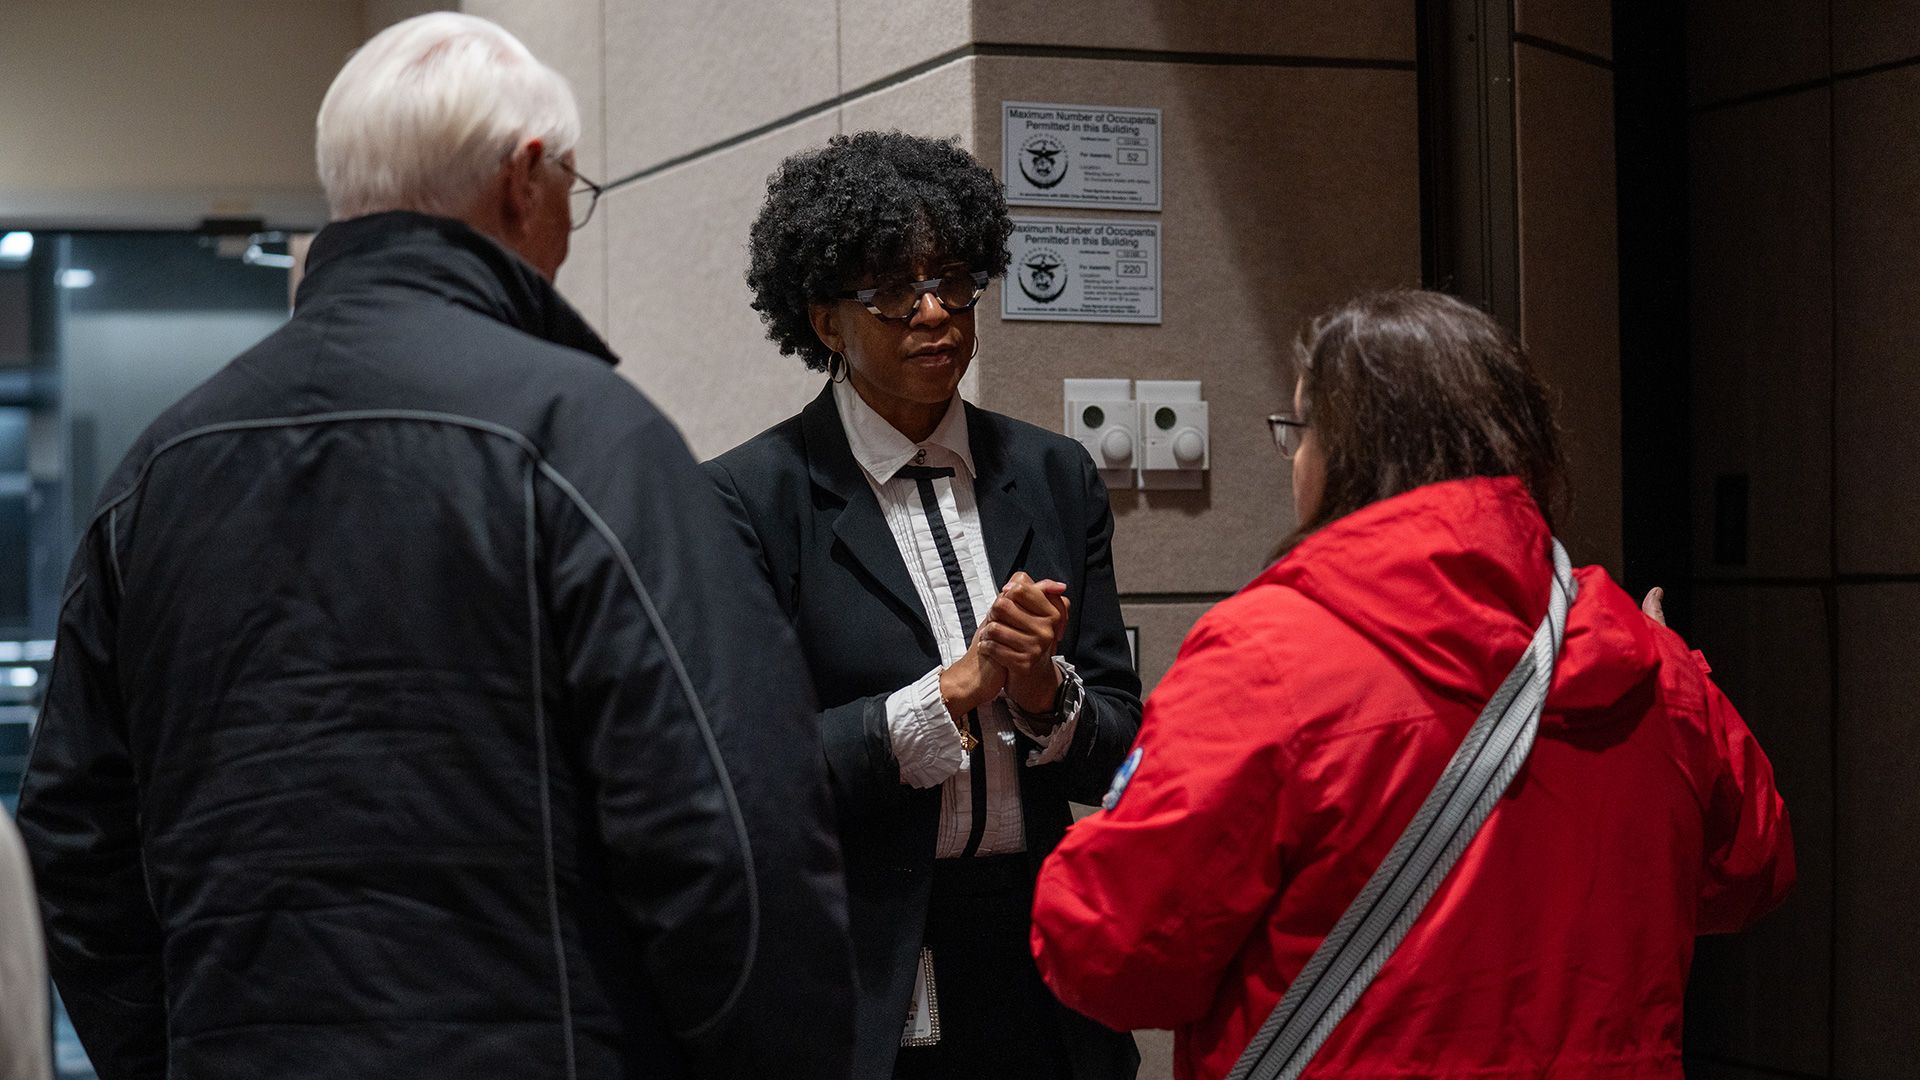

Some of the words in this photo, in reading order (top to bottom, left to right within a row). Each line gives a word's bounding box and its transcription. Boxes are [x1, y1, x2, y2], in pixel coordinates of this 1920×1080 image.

[1009, 110, 1054, 119] Maximum
[1056, 112, 1092, 121] Number
[1095, 114, 1104, 123] of
[1106, 114, 1157, 125] Occupants
[1026, 120, 1070, 131] Permitted
[1072, 122, 1081, 131] in
[1083, 124, 1100, 133] this
[1102, 124, 1140, 136] Building
[1127, 152, 1139, 162] 52
[1014, 224, 1053, 233] aximum
[1056, 225, 1092, 235] Number
[1095, 227, 1104, 235] of
[1106, 227, 1156, 237] Occupants
[1025, 234, 1069, 245] Permitted
[1072, 236, 1080, 245] in
[1082, 237, 1099, 245] this
[1102, 237, 1139, 248] Building
[1123, 264, 1141, 274] 220
